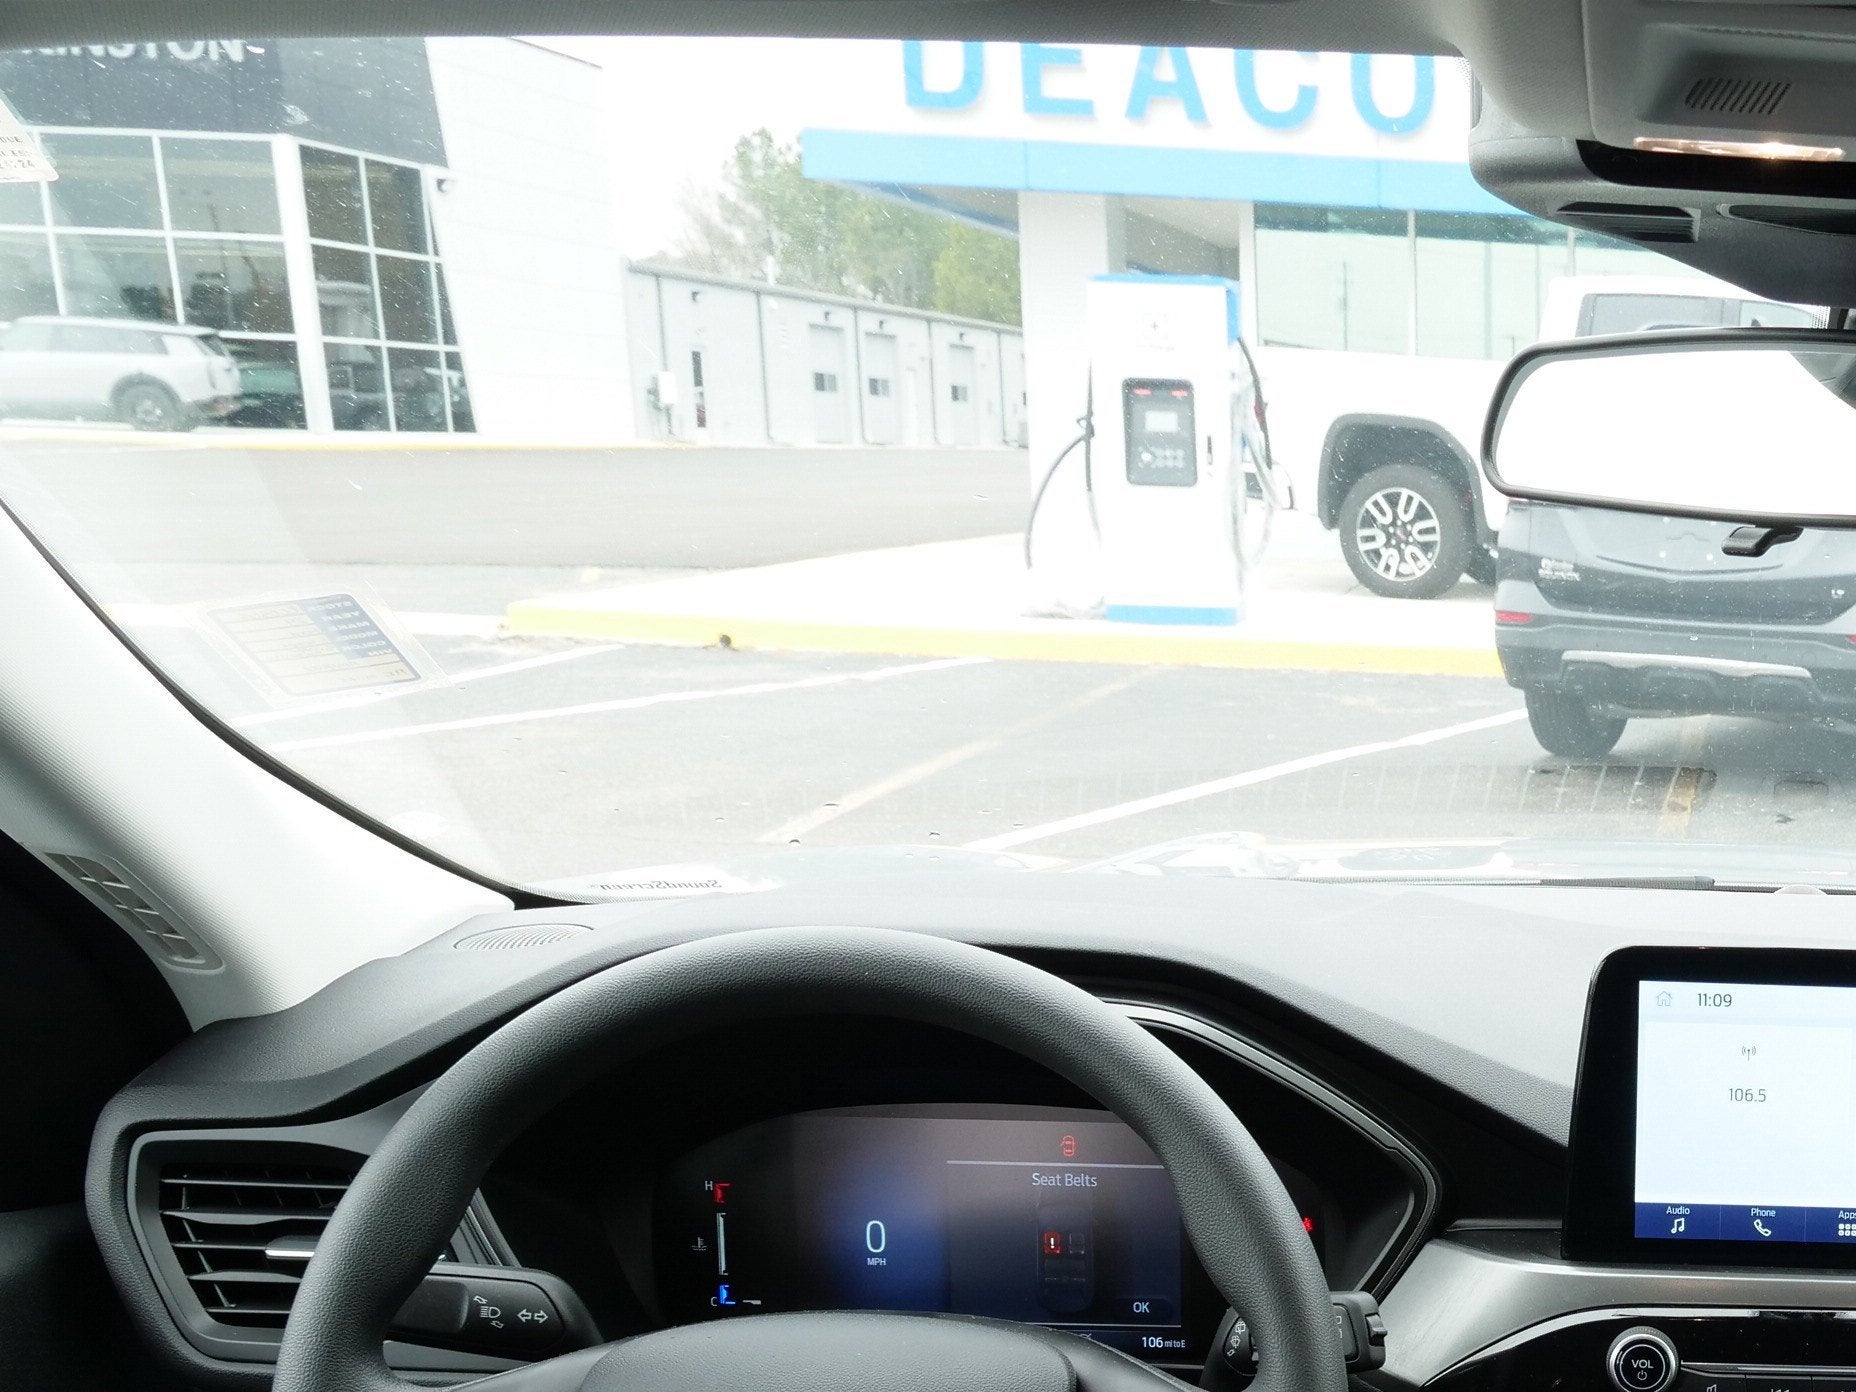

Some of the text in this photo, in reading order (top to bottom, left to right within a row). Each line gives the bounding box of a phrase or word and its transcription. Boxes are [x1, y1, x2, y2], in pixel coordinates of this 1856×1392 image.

[1697, 993, 1733, 1007] 11:09
[1729, 1088, 1767, 1102] 106.5
[705, 1180, 713, 1191] H
[1032, 1173, 1098, 1187] Seat Belts
[1666, 1206, 1690, 1215] Audio
[1751, 1207, 1776, 1218] Phone
[866, 1220, 886, 1253] 0
[867, 1257, 887, 1266] MPH
[1133, 1302, 1150, 1313] OK
[1142, 1336, 1164, 1348] 106
[1631, 1359, 1654, 1369] VOL
